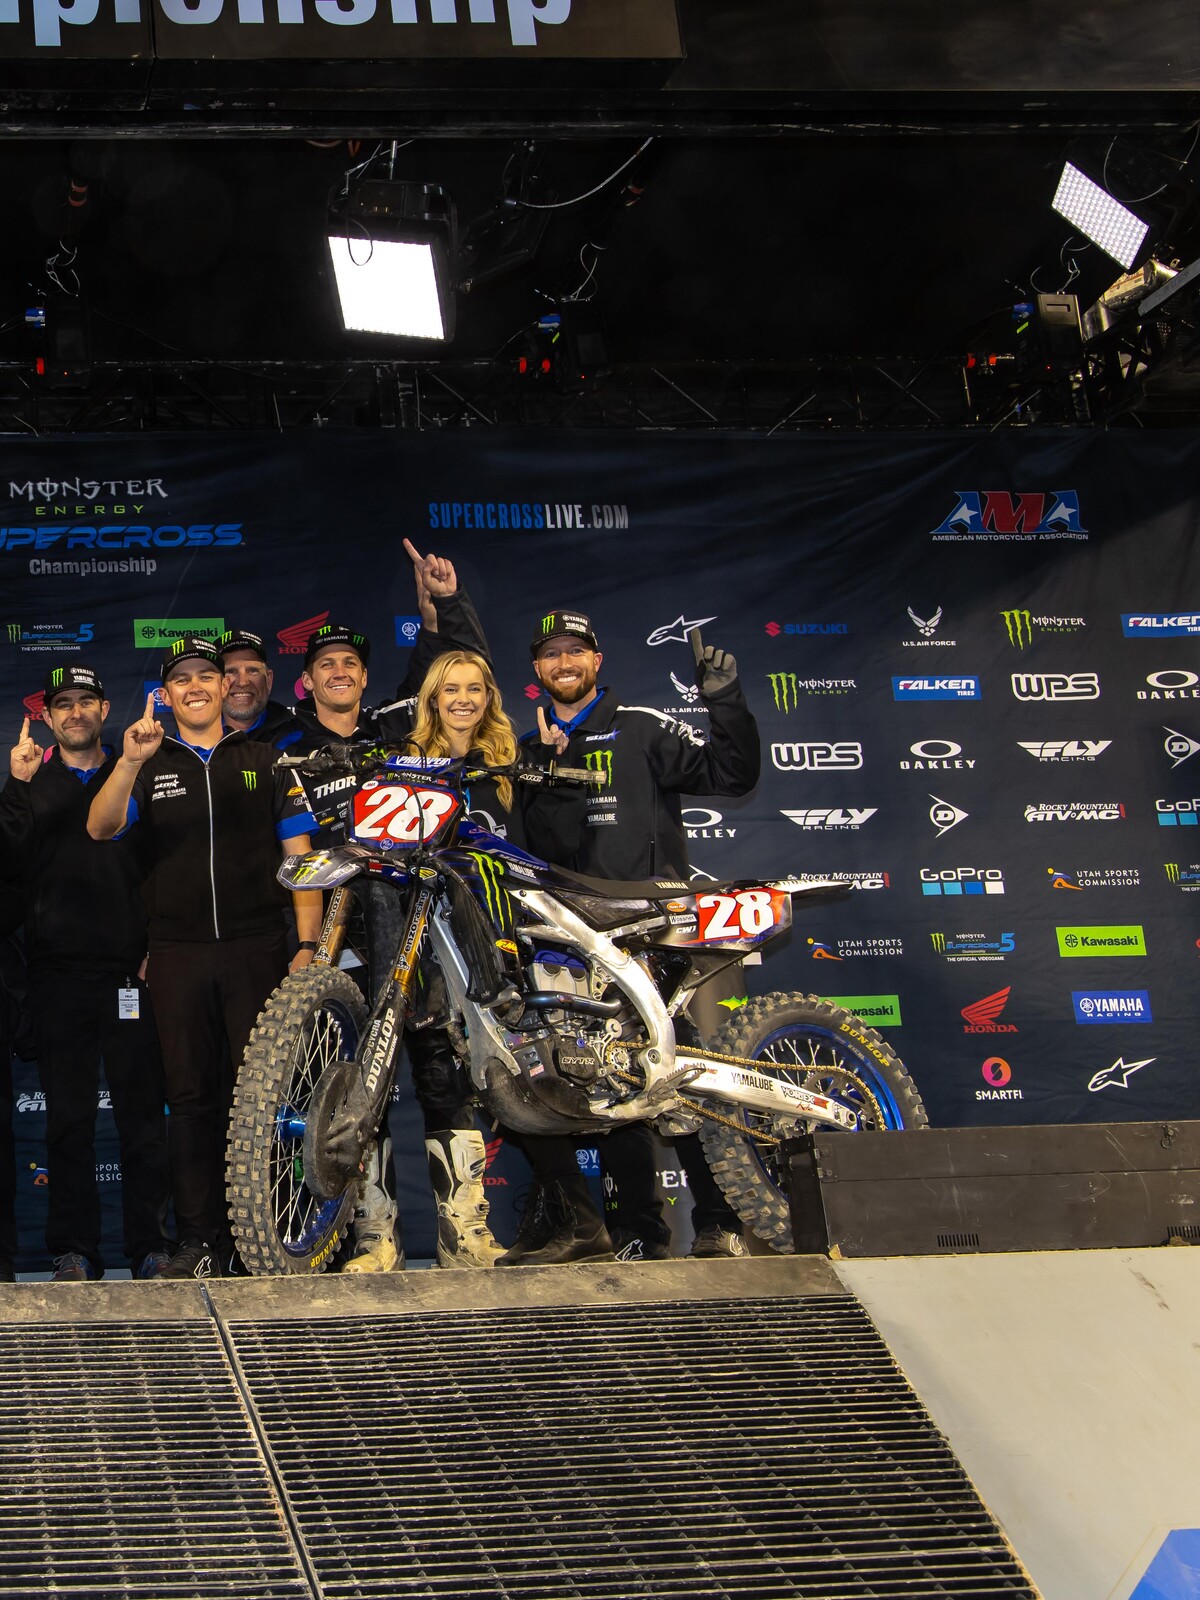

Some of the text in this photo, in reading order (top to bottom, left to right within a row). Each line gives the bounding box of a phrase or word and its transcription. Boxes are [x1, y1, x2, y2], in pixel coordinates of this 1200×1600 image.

[36, 505, 144, 515] ENERGY
[429, 503, 629, 529] SUPERCROSSLIVE.COM
[930, 489, 1089, 534] AMA
[1039, 532, 1088, 540] ASSOCIATION
[29, 557, 157, 577] Championship
[75, 624, 95, 642] 5
[158, 627, 218, 638] Kawasaki
[784, 623, 848, 634] SUZUKI
[899, 679, 975, 691] FALKEN
[1011, 673, 1100, 701] WPS
[1137, 690, 1200, 700] OAKLE
[1016, 740, 1113, 757] FLY
[771, 742, 863, 771] WPS
[900, 759, 976, 770] OAKLEY
[313, 775, 357, 799] THOR
[591, 796, 617, 804] YAMAHA
[1155, 799, 1200, 812] GoP
[1038, 803, 1068, 811] ROCKY
[354, 786, 452, 841] 28
[587, 813, 616, 823] YAMALUBE
[779, 808, 878, 825] FLY
[687, 828, 737, 838] KLEY
[801, 872, 882, 881] ROCKY MOUNTAIN
[920, 867, 1004, 881] GoPro
[1077, 869, 1139, 878] UTAH SPORTS
[656, 882, 689, 890] YAMAHA
[1078, 878, 1140, 886] COMMISSION
[699, 892, 774, 939] 28
[837, 938, 902, 948] UTAH SPORTS
[998, 933, 1015, 952] 5
[1081, 935, 1139, 947] Kawasaki
[839, 948, 903, 957] COMMISSION
[851, 1005, 894, 1017] wasaki
[1094, 998, 1144, 1012] YAMAHA
[368, 1019, 382, 1047] CYCRA
[963, 1024, 1019, 1033] HONDA
[366, 1007, 396, 1092] DUNLOP
[840, 1023, 890, 1067] DUNLOP
[731, 1072, 774, 1091] YAMALUBE
[976, 1089, 1023, 1100] SMARTFI
[310, 1230, 339, 1268] DUNLOP
